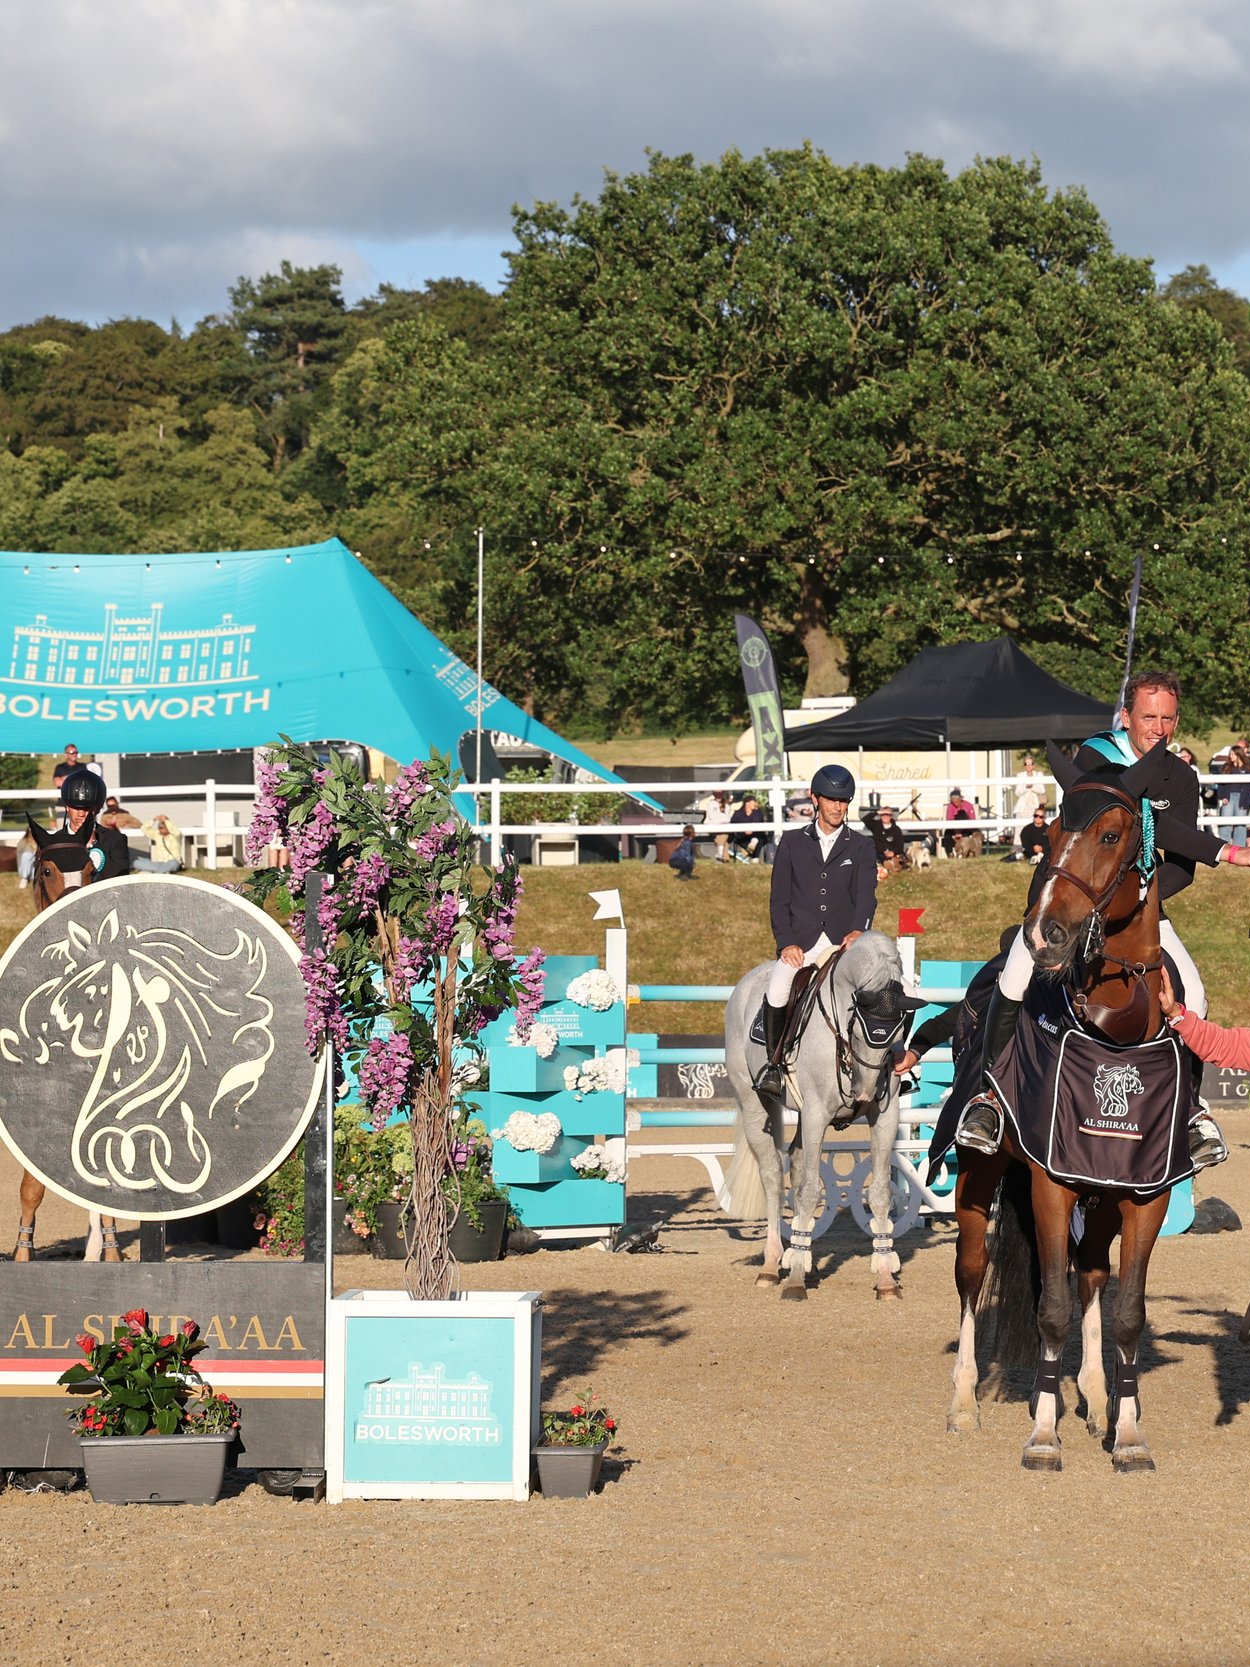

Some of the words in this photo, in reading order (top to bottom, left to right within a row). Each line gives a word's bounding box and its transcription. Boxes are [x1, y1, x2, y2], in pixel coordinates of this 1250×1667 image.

[557, 1031, 584, 1039] WORTH
[1084, 1117, 1096, 1127] AL
[1096, 1119, 1139, 1132] SHIRA'AA
[4, 1313, 70, 1349] AL
[356, 1424, 499, 1443] BOLESWORTH
